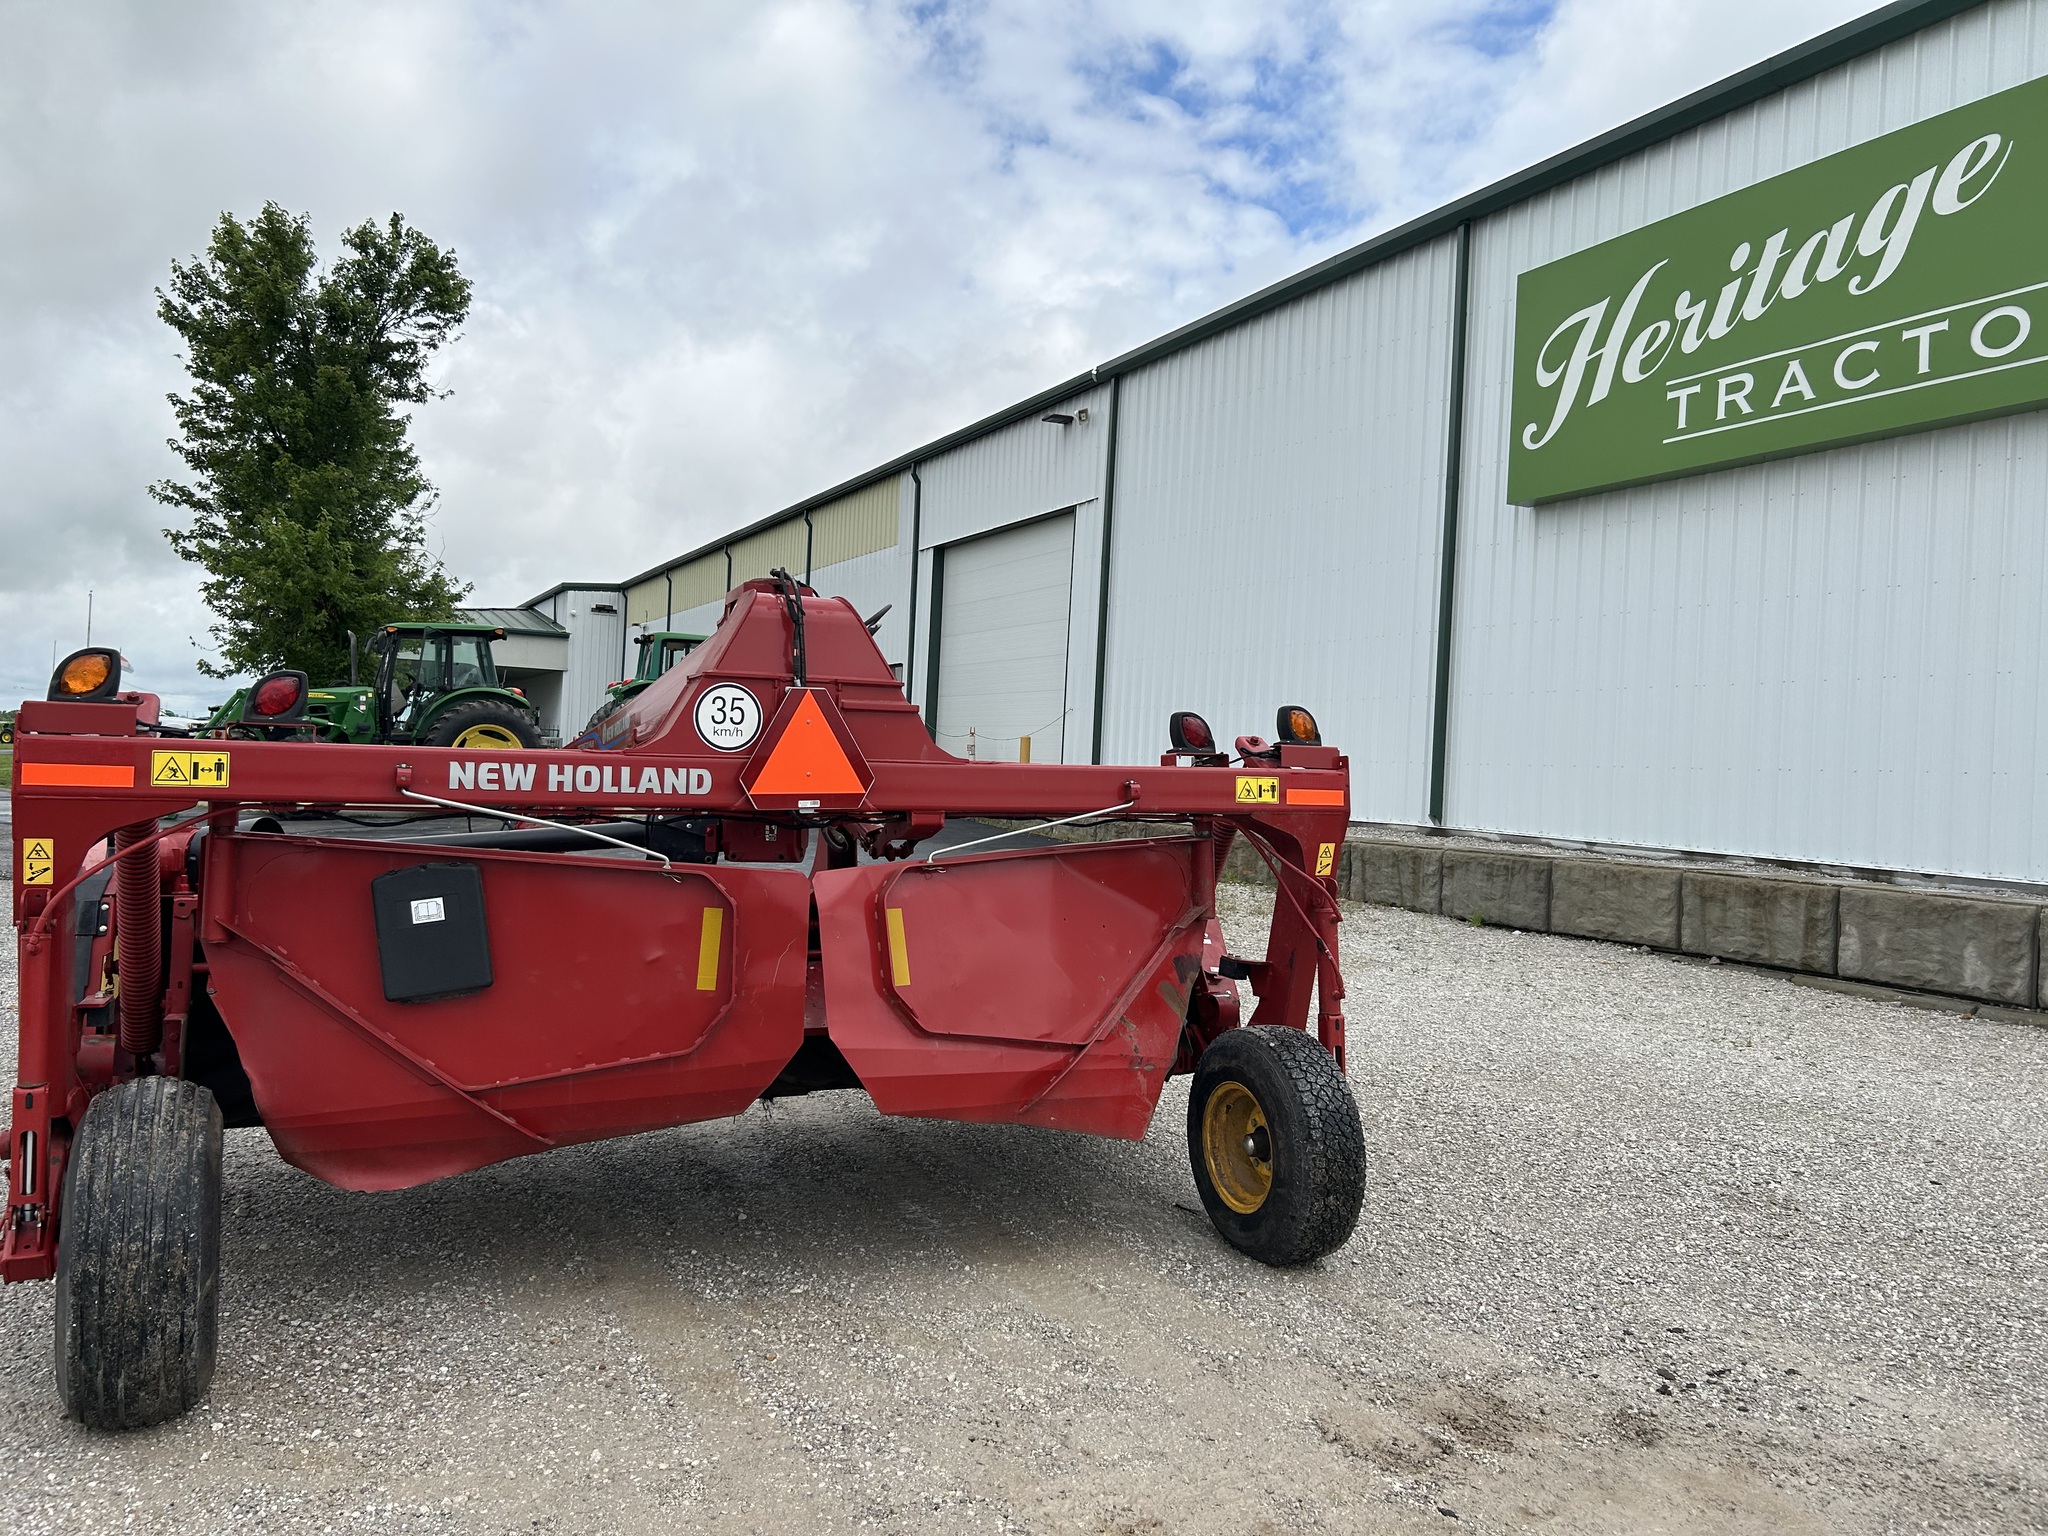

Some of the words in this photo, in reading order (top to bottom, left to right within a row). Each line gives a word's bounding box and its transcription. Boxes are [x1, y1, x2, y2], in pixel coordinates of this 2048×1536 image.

[1522, 133, 2013, 450] Heritage
[711, 695, 745, 725] 35
[713, 726, 743, 737] km/h
[448, 761, 537, 791] NEW
[548, 763, 713, 795] HOLLAND
